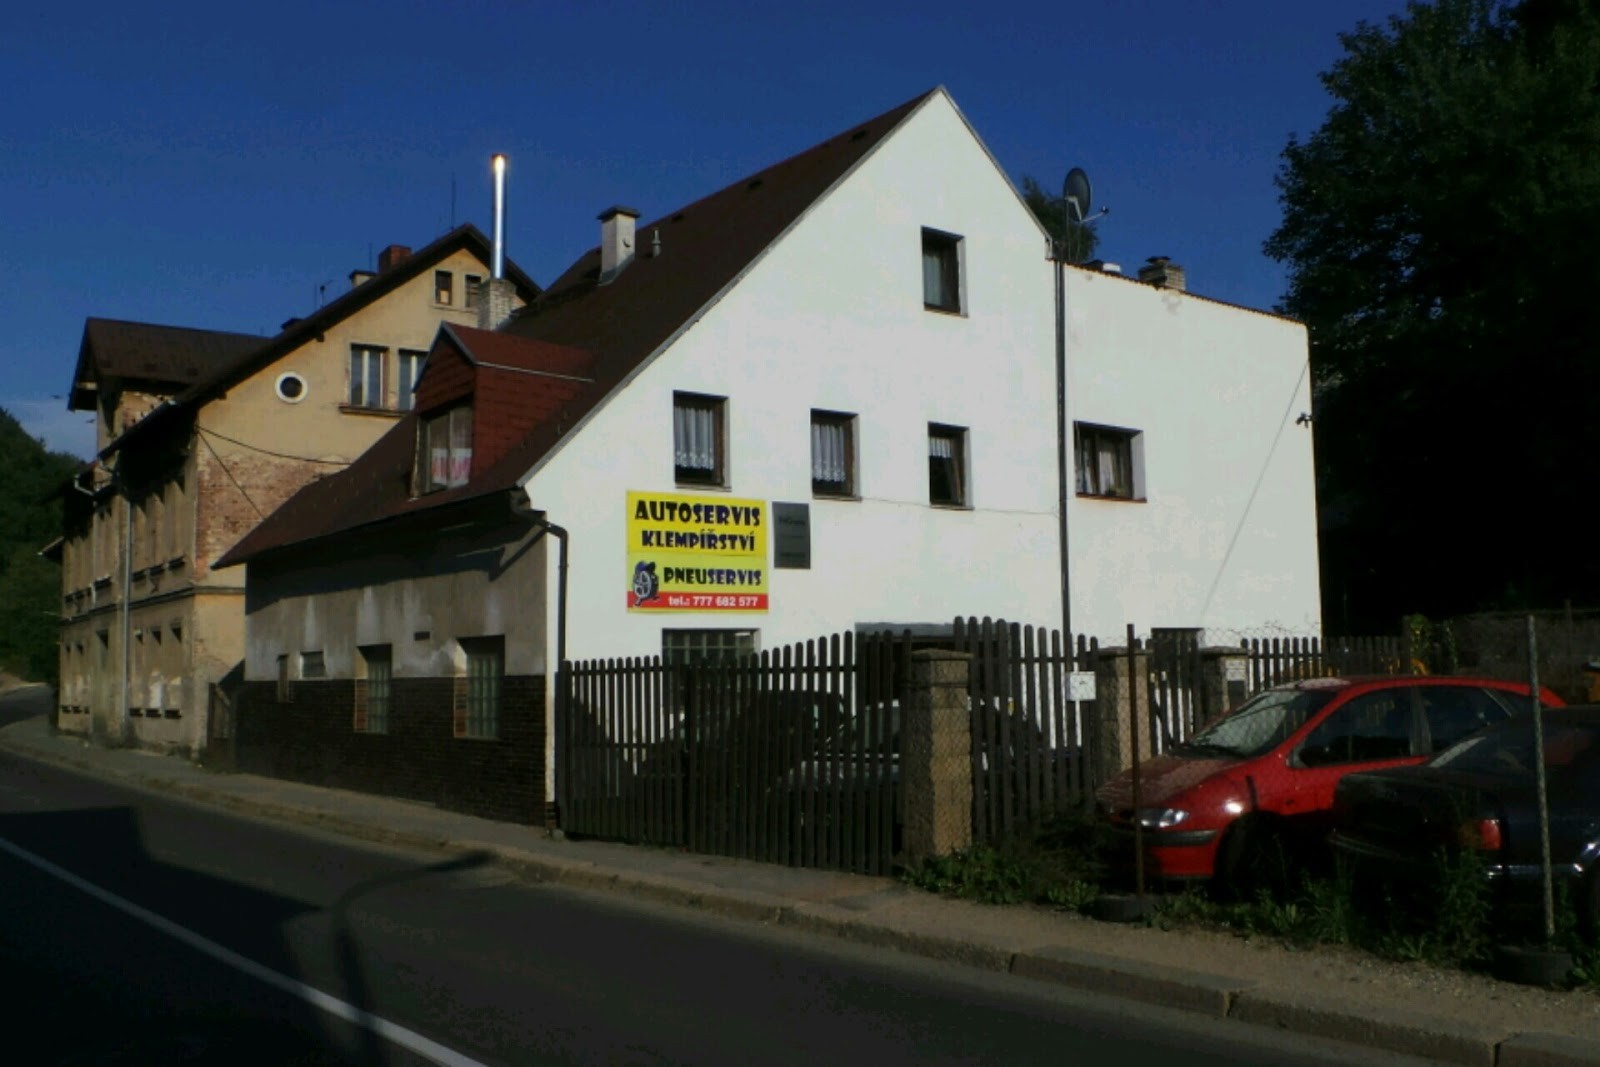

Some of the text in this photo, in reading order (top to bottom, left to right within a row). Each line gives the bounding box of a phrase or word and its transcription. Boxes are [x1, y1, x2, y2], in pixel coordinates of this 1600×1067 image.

[635, 499, 760, 526] AUTOSERVIS
[641, 528, 755, 551] KLEMPÍŘSTVÍ
[663, 567, 762, 586] PNEUSERVIS
[693, 595, 713, 607] 777
[738, 596, 758, 607] 577
